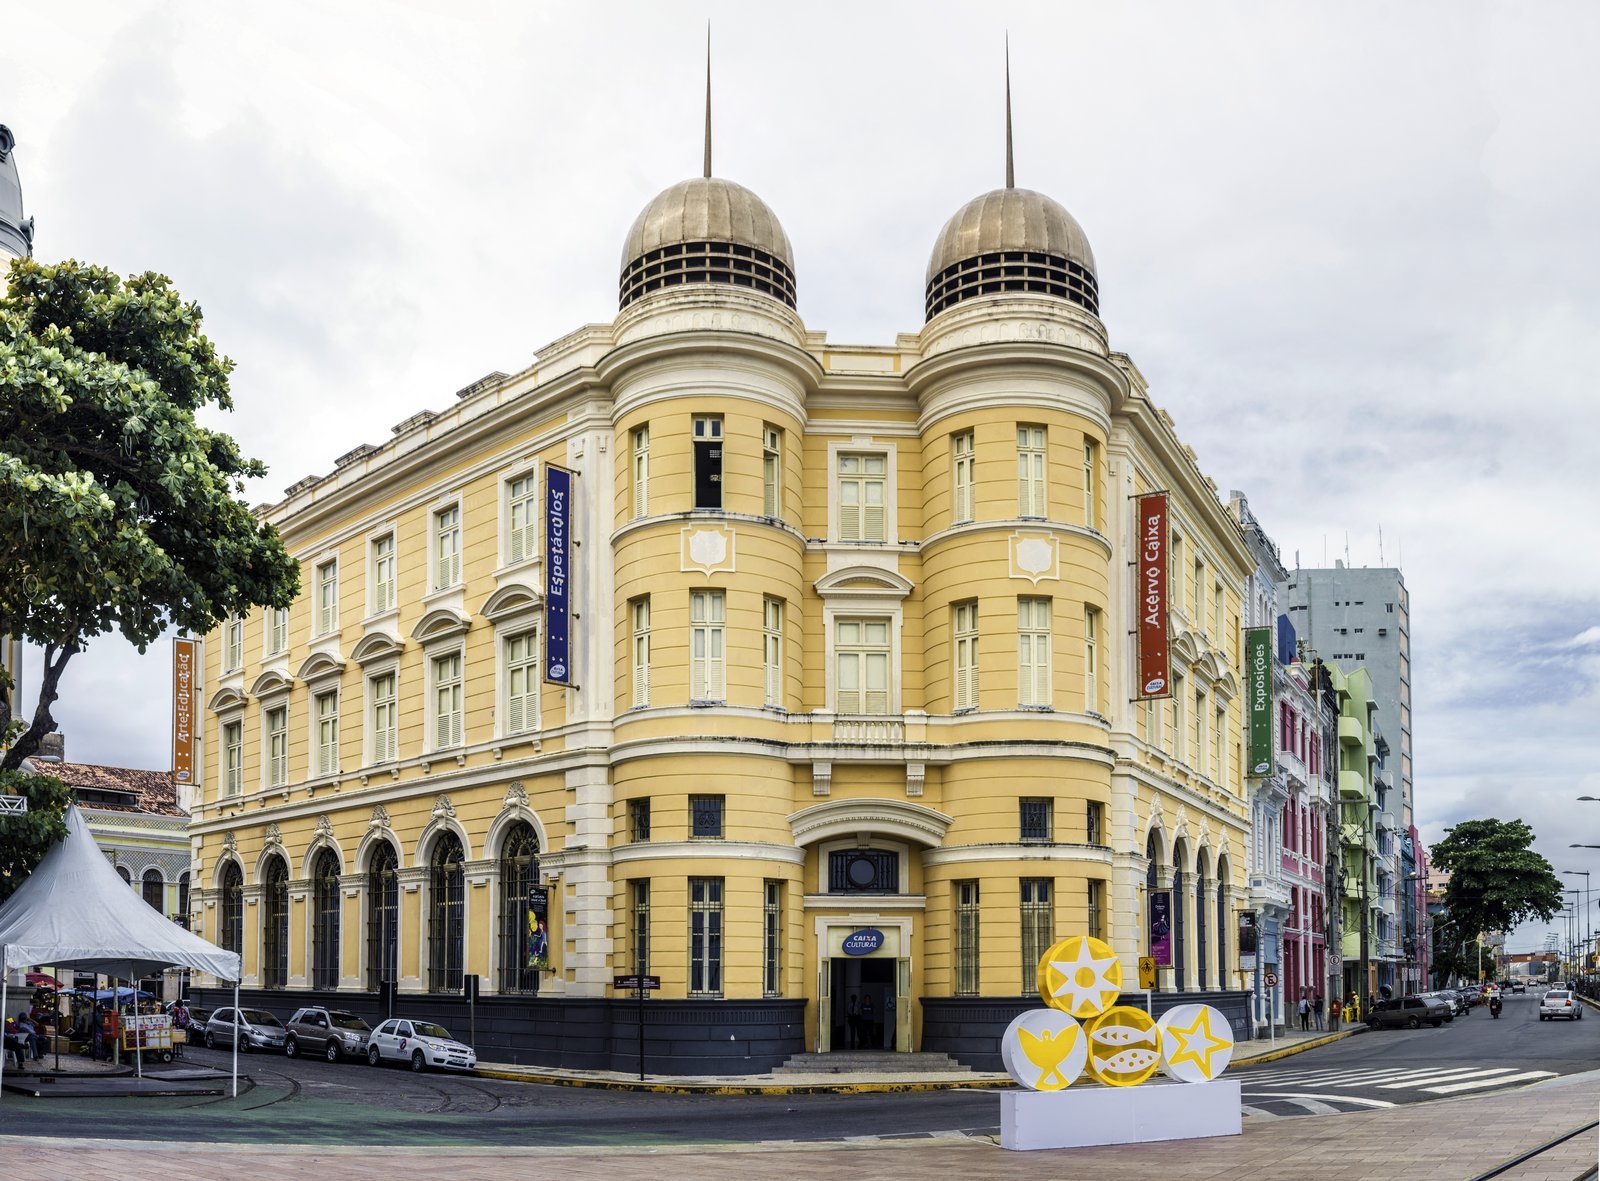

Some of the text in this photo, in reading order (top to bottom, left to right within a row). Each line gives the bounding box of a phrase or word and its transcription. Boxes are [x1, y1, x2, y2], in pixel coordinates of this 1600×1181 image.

[550, 488, 565, 597] Espetáculos
[1145, 514, 1160, 627] Acervo Caixa
[177, 654, 191, 743] Arte-Educação
[1253, 643, 1267, 711] Exposições
